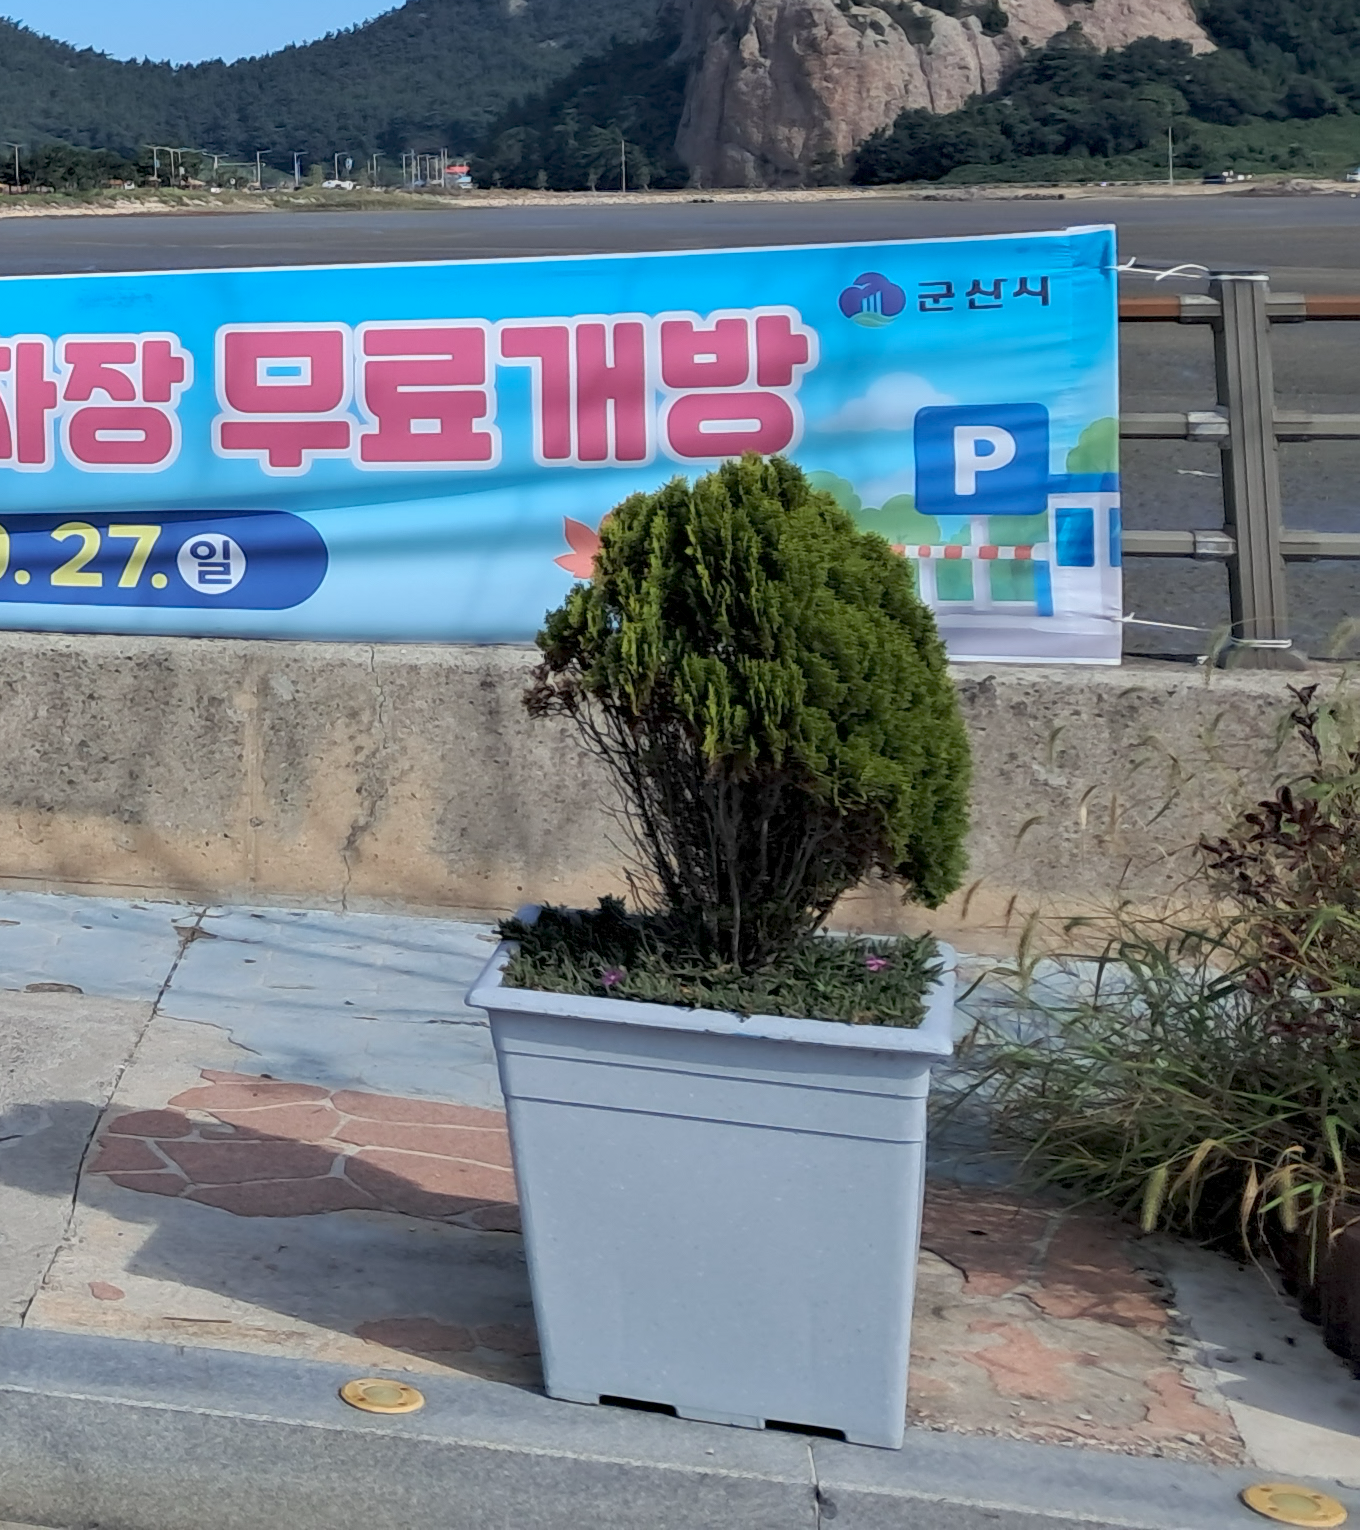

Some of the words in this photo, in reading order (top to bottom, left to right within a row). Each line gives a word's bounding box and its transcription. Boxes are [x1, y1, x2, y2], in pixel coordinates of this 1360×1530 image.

[916, 274, 1051, 313] 군산시
[219, 314, 811, 468] 무료개방
[953, 425, 1017, 496] P
